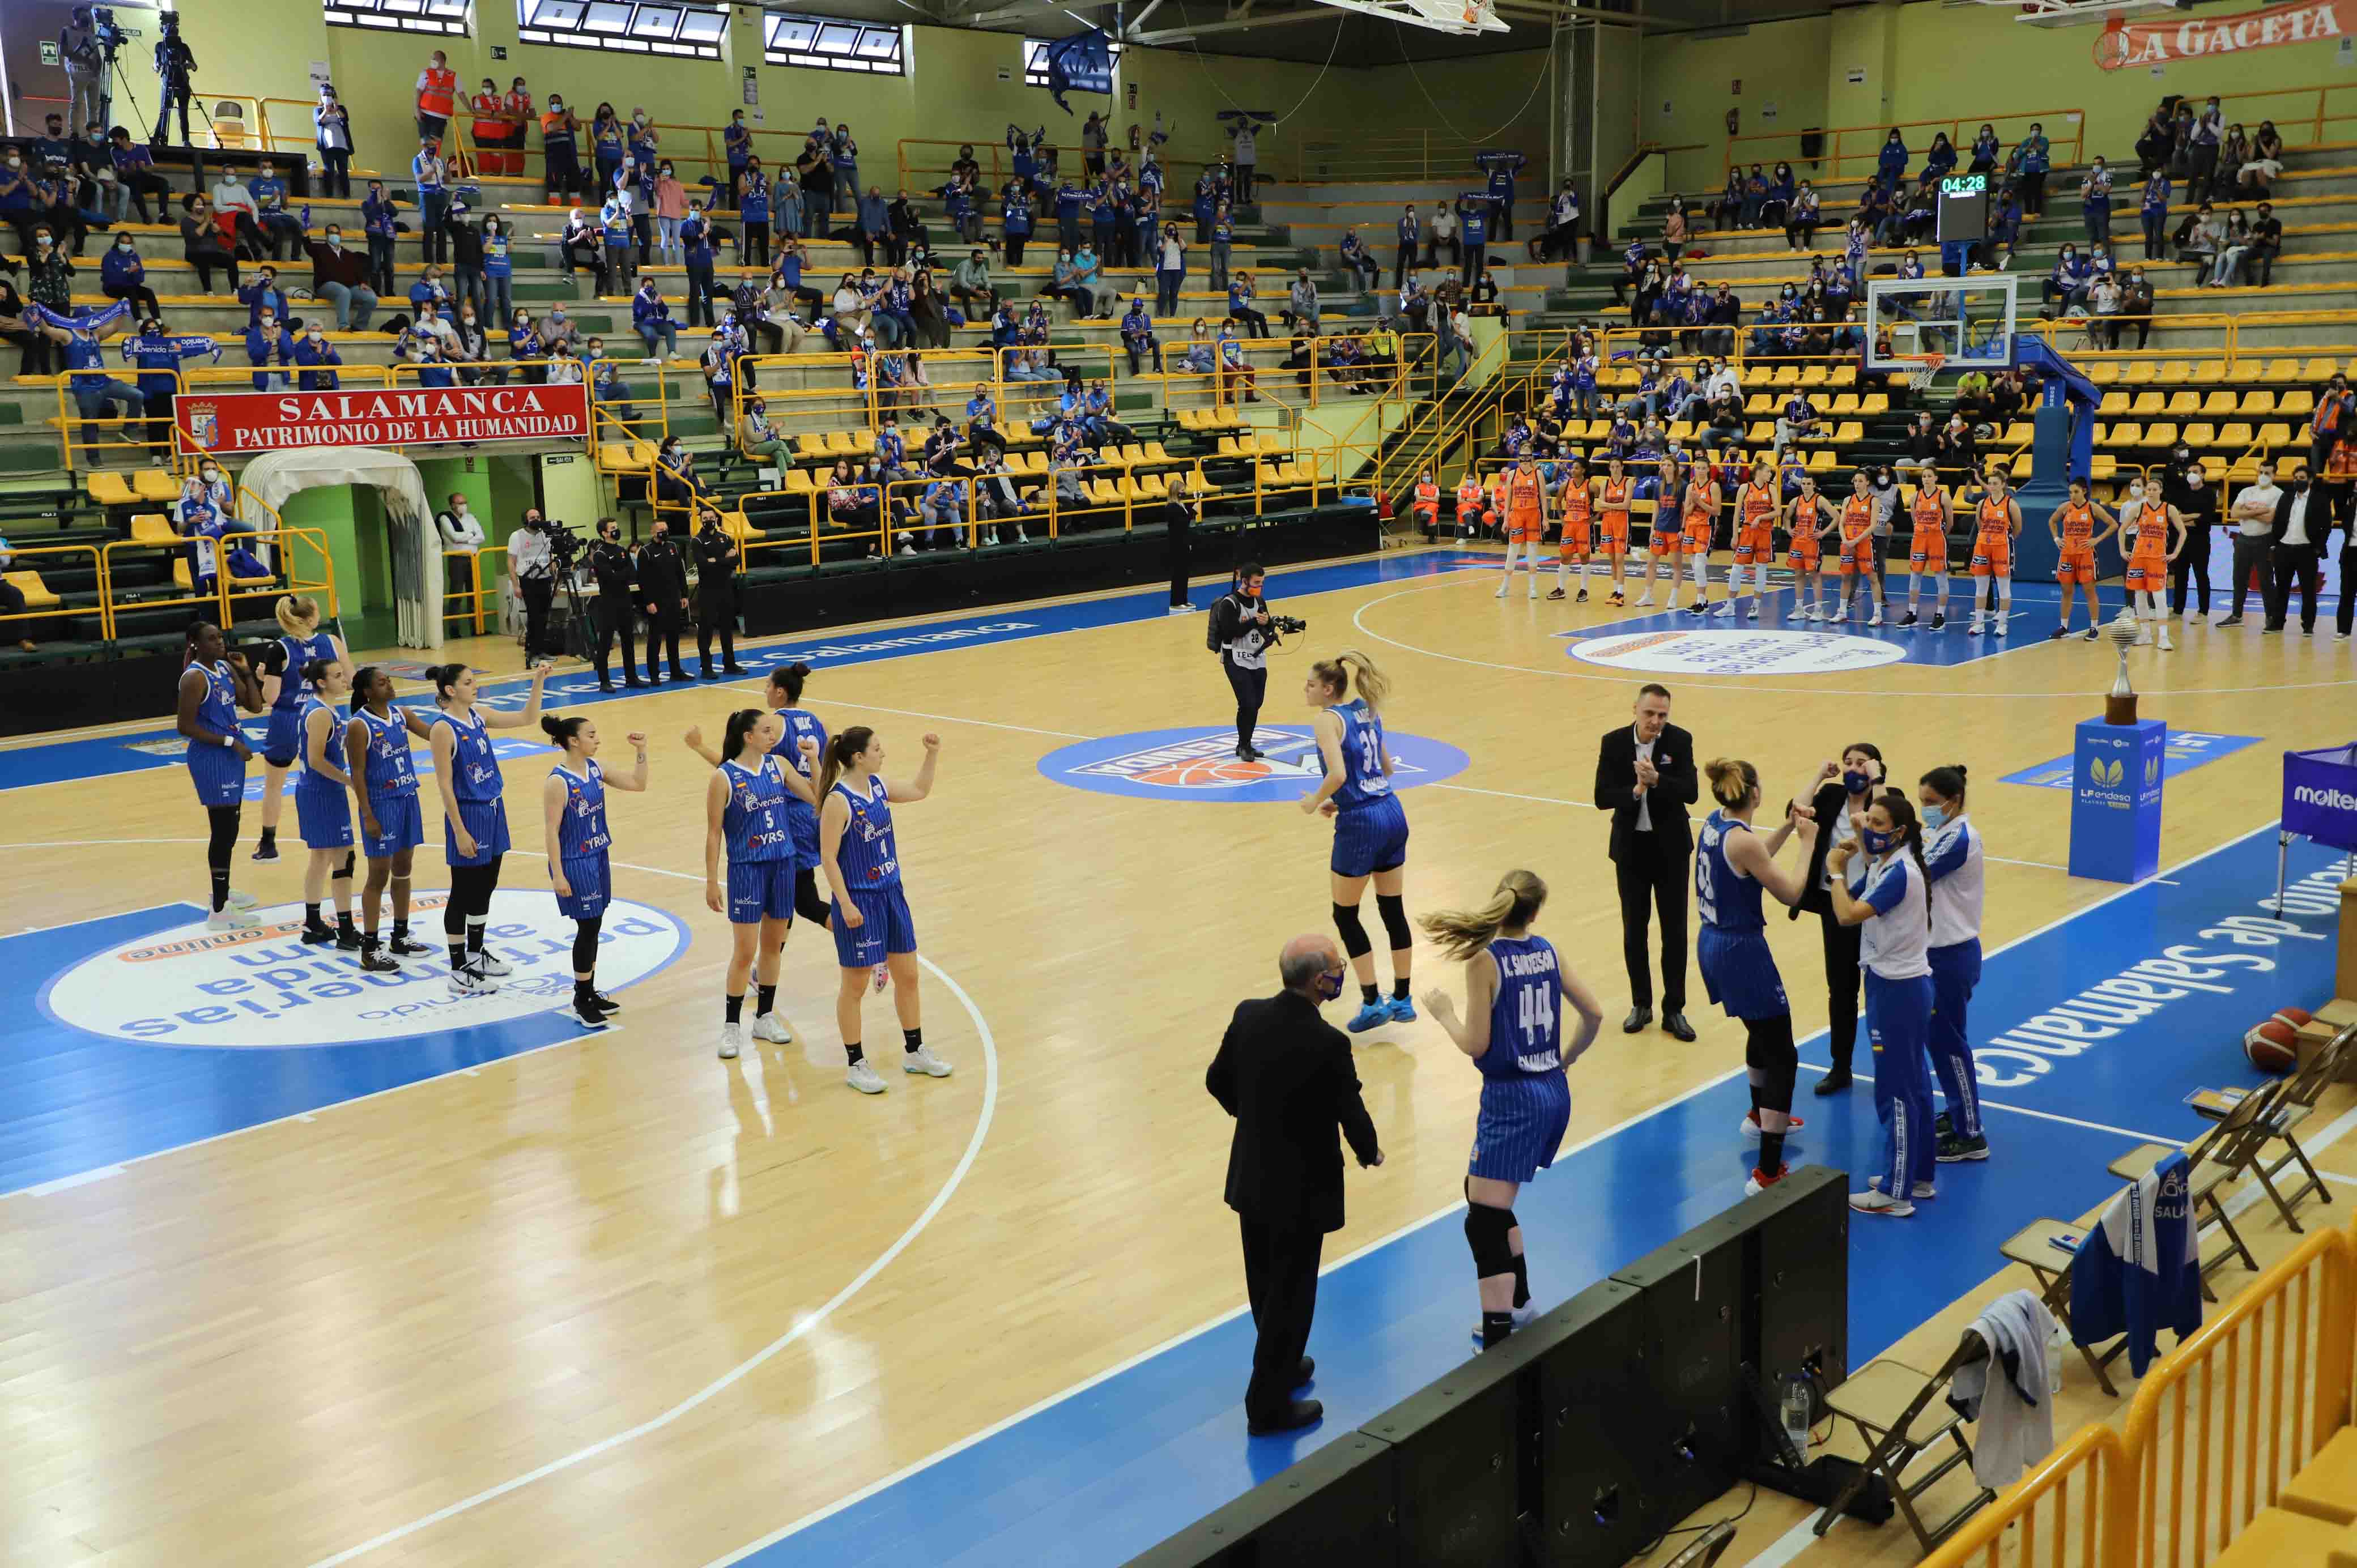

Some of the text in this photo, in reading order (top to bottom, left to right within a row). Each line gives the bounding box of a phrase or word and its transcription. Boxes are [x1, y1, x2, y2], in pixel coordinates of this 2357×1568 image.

[2177, 4, 2341, 56] GACETA
[1942, 174, 1986, 193] 04:28
[278, 390, 544, 422] SALAMANCA
[233, 414, 577, 448] PATRIMONIO DE LA HUMANIDAD
[763, 621, 1041, 662] Salamanca
[1252, 633, 1259, 644] 28
[476, 737, 488, 755] 10
[2094, 791, 2131, 803] endesa
[591, 815, 597, 833] 6
[765, 810, 774, 829] 5
[880, 839, 888, 858] 4
[129, 929, 265, 960] online
[2198, 915, 2328, 947] de
[1519, 980, 1555, 1046] 44
[1973, 944, 2275, 1087] Salamanca
